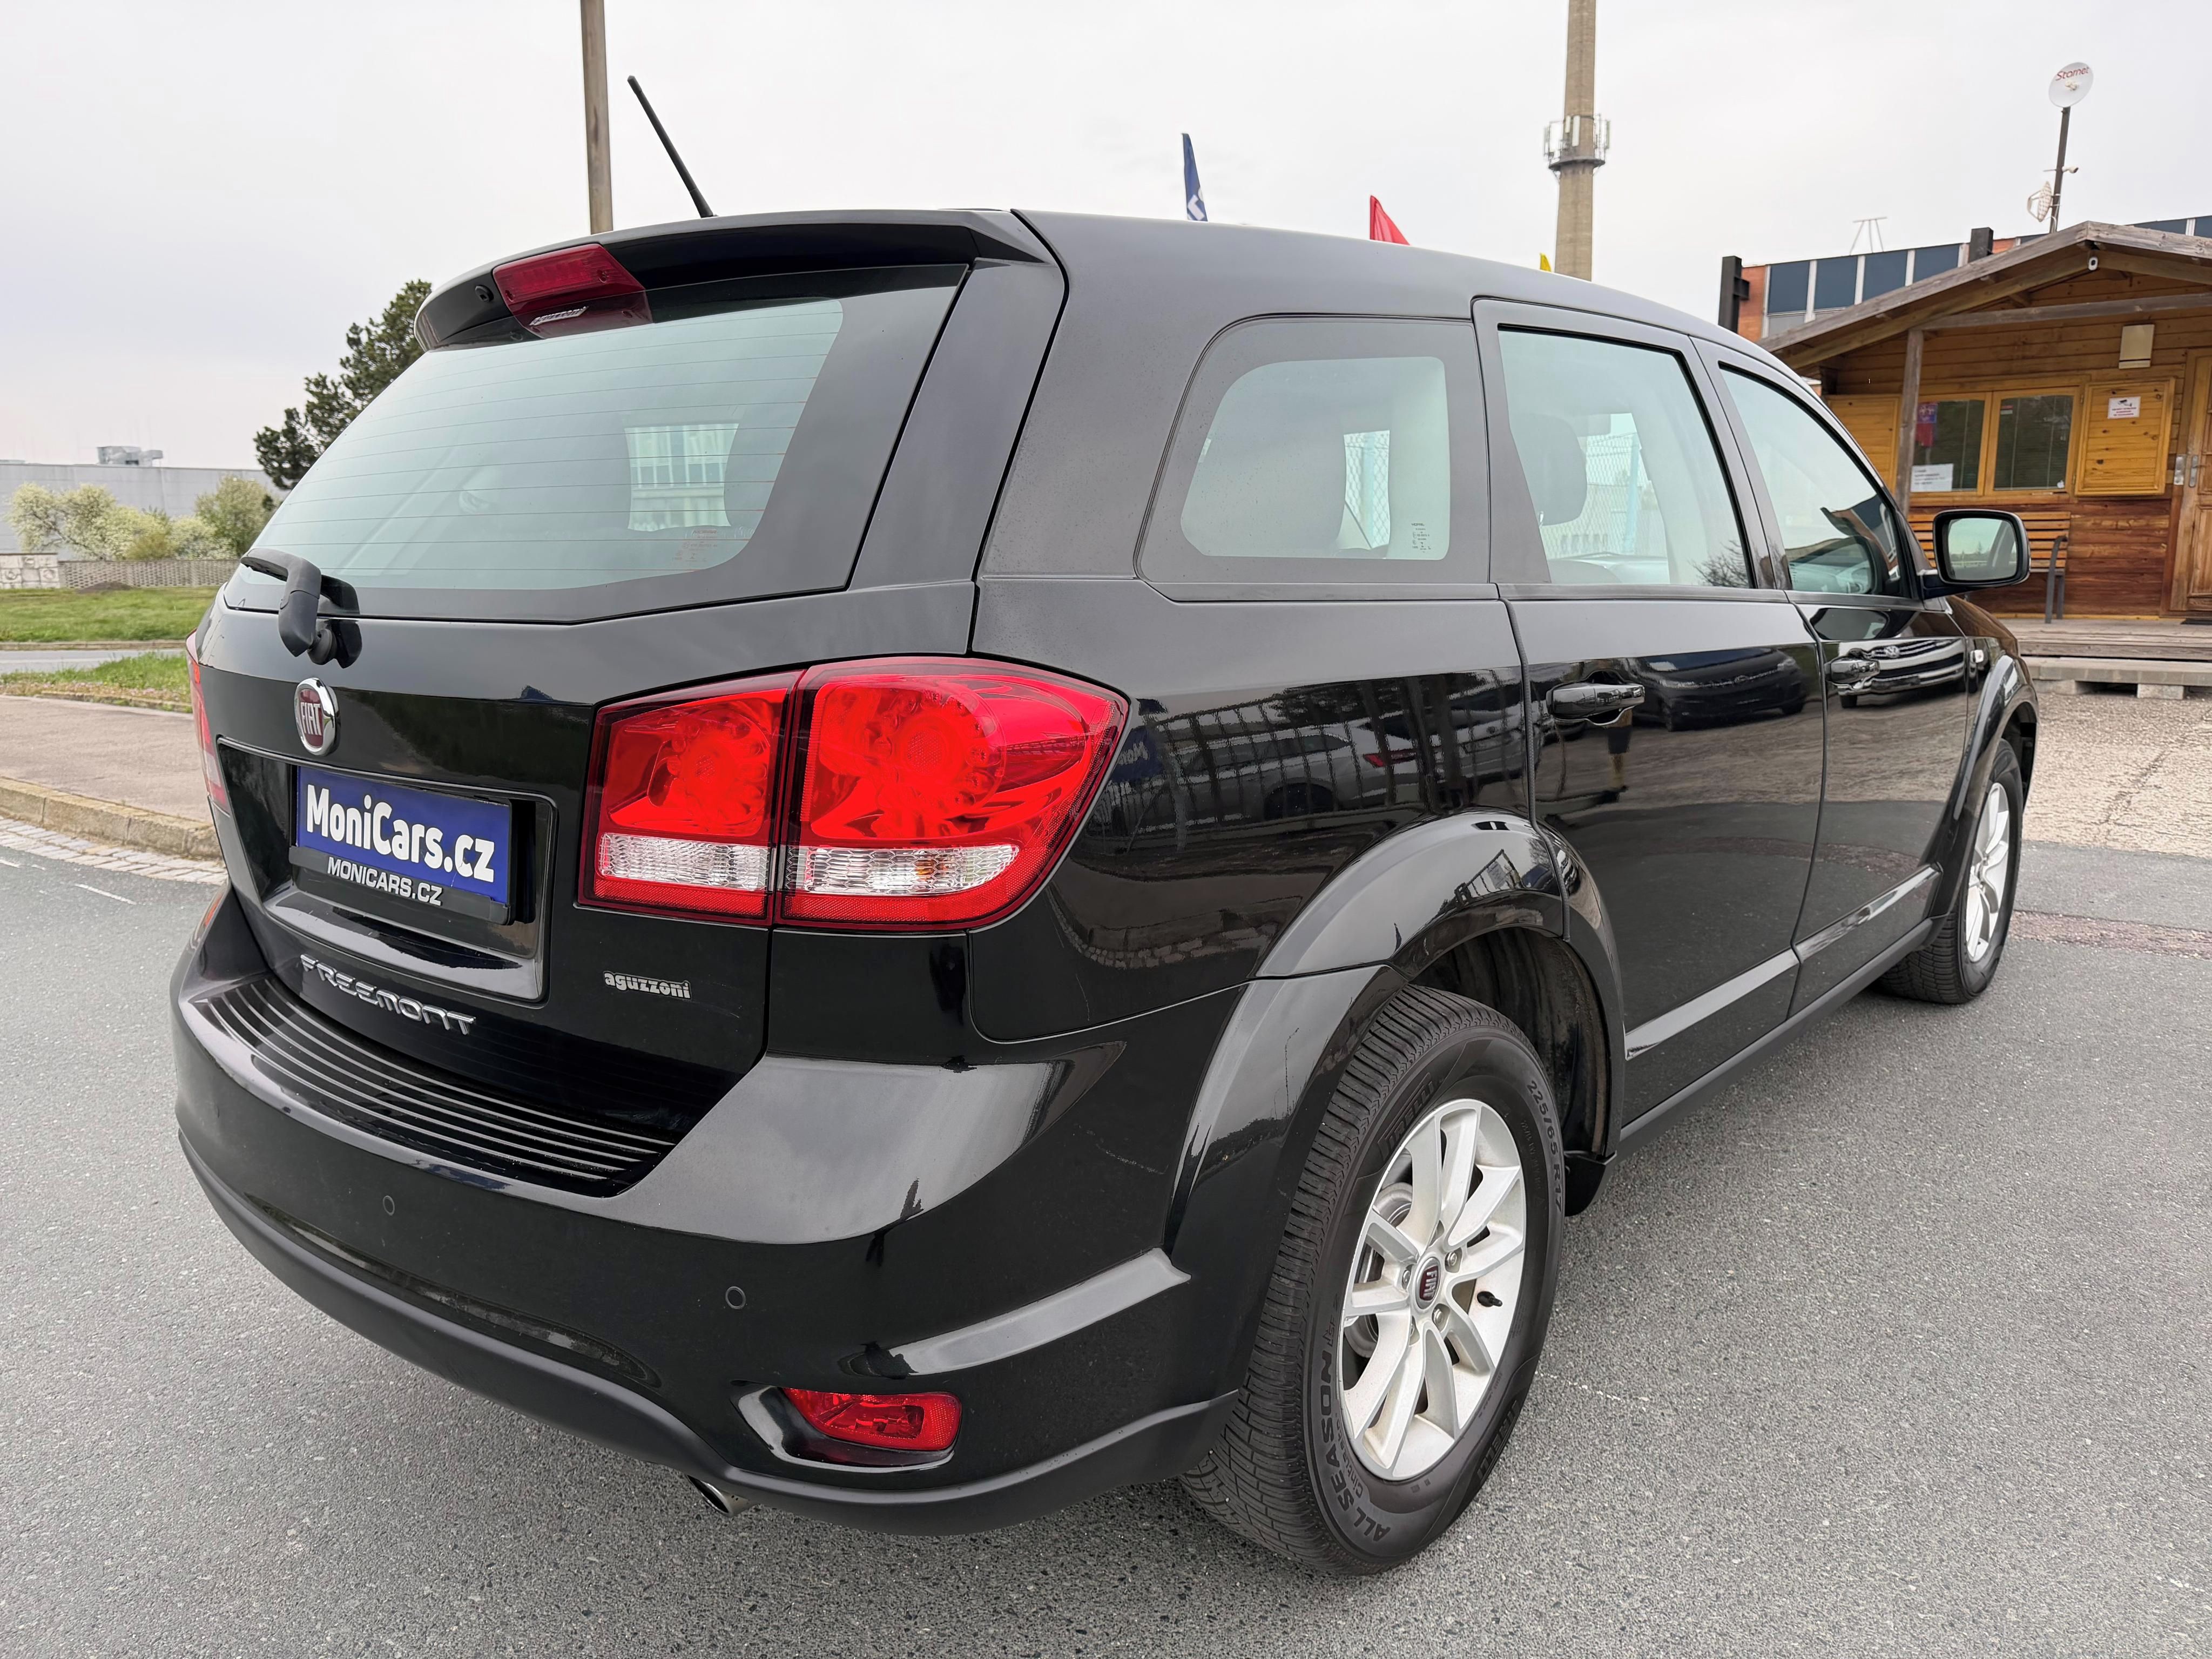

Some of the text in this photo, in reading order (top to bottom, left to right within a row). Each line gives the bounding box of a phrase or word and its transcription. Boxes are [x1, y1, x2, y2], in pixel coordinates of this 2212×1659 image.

[300, 702, 322, 736] FIAT
[306, 784, 495, 883] MoniCars.cz
[327, 856, 443, 906] MONICARS.CZ
[300, 954, 476, 1036] FREEMONT
[604, 972, 691, 999] aguzzoni
[1527, 1081, 1558, 1155] 225/65
[1553, 1164, 1562, 1212] R17
[1422, 1270, 1438, 1298] FIAT
[1320, 1350, 1354, 1512] SEASON
[1353, 1506, 1391, 1542] ALL
